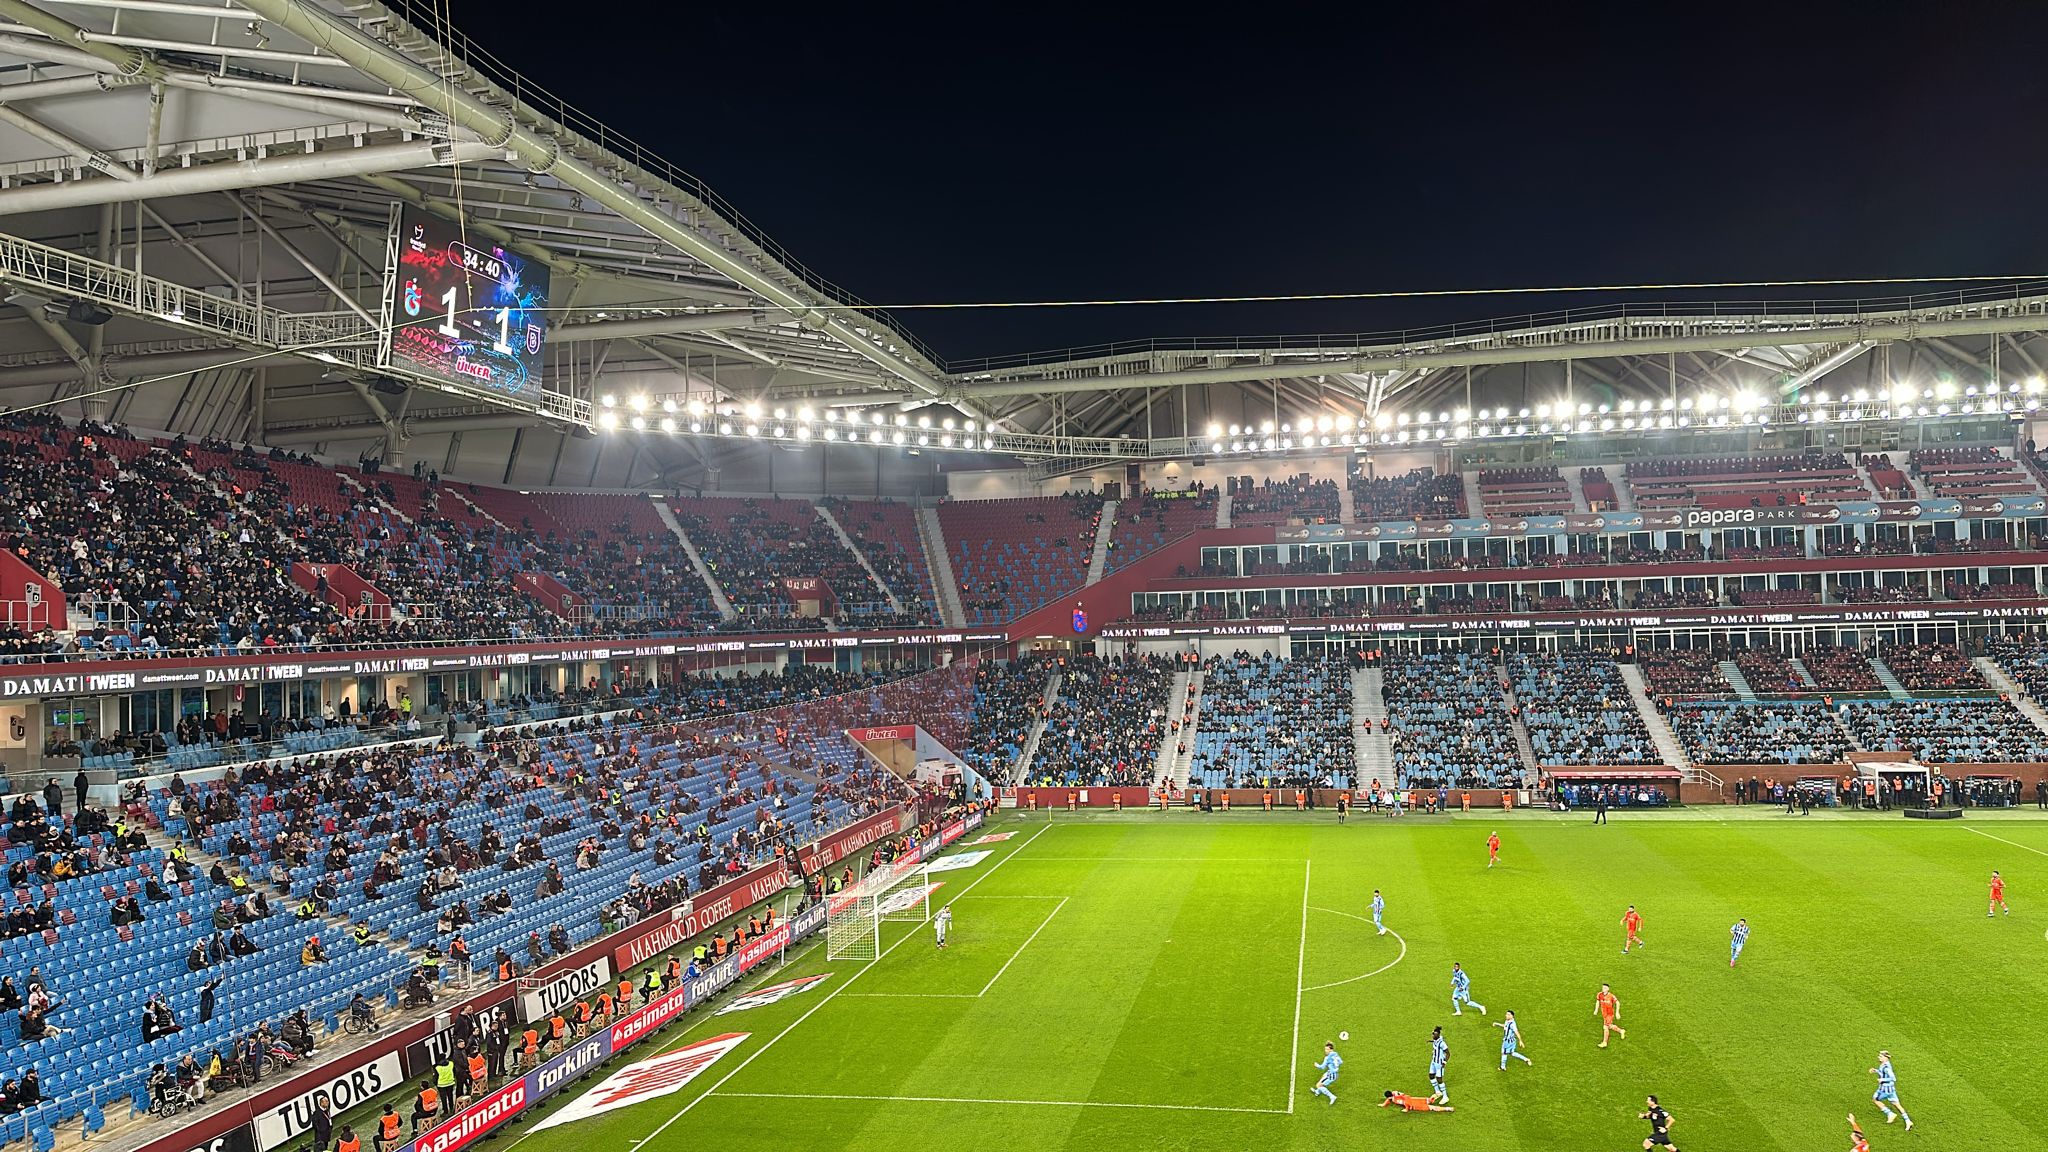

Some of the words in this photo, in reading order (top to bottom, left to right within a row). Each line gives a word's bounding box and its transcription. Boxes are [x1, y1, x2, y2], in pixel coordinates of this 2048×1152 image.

[439, 287, 460, 339] 1
[493, 307, 512, 356] 1
[456, 356, 491, 380] ÜLKER
[1688, 509, 1755, 527] papara
[1758, 511, 1795, 519] PARK
[321, 567, 327, 578] C
[1711, 615, 1754, 626] DAMAT
[1845, 612, 1889, 620] DAMAT
[1983, 608, 2029, 616] DAMAT
[1453, 621, 1493, 629] DAMAT
[1580, 618, 1626, 626] DAMAT
[790, 639, 826, 647] DAMAT
[355, 660, 398, 673] DAMAT
[401, 659, 428, 670] TWEEN
[470, 655, 502, 666] DAMAT
[206, 668, 259, 682] DAMAT
[267, 665, 302, 679] TWEEN
[4, 677, 77, 695] DAMAT
[87, 674, 135, 690] TWEEN
[866, 729, 898, 740] ÜLKER
[840, 828, 875, 857] MAHMOOD
[874, 820, 895, 840] COFFEE
[701, 896, 733, 929] COFFEE
[795, 906, 826, 935] forklift
[746, 928, 790, 962] asimato
[538, 963, 599, 1014] TUDORS
[691, 960, 734, 1000] forklift
[623, 992, 683, 1040] asimato
[538, 1041, 601, 1092] forklift
[434, 1087, 524, 1152] asimato
